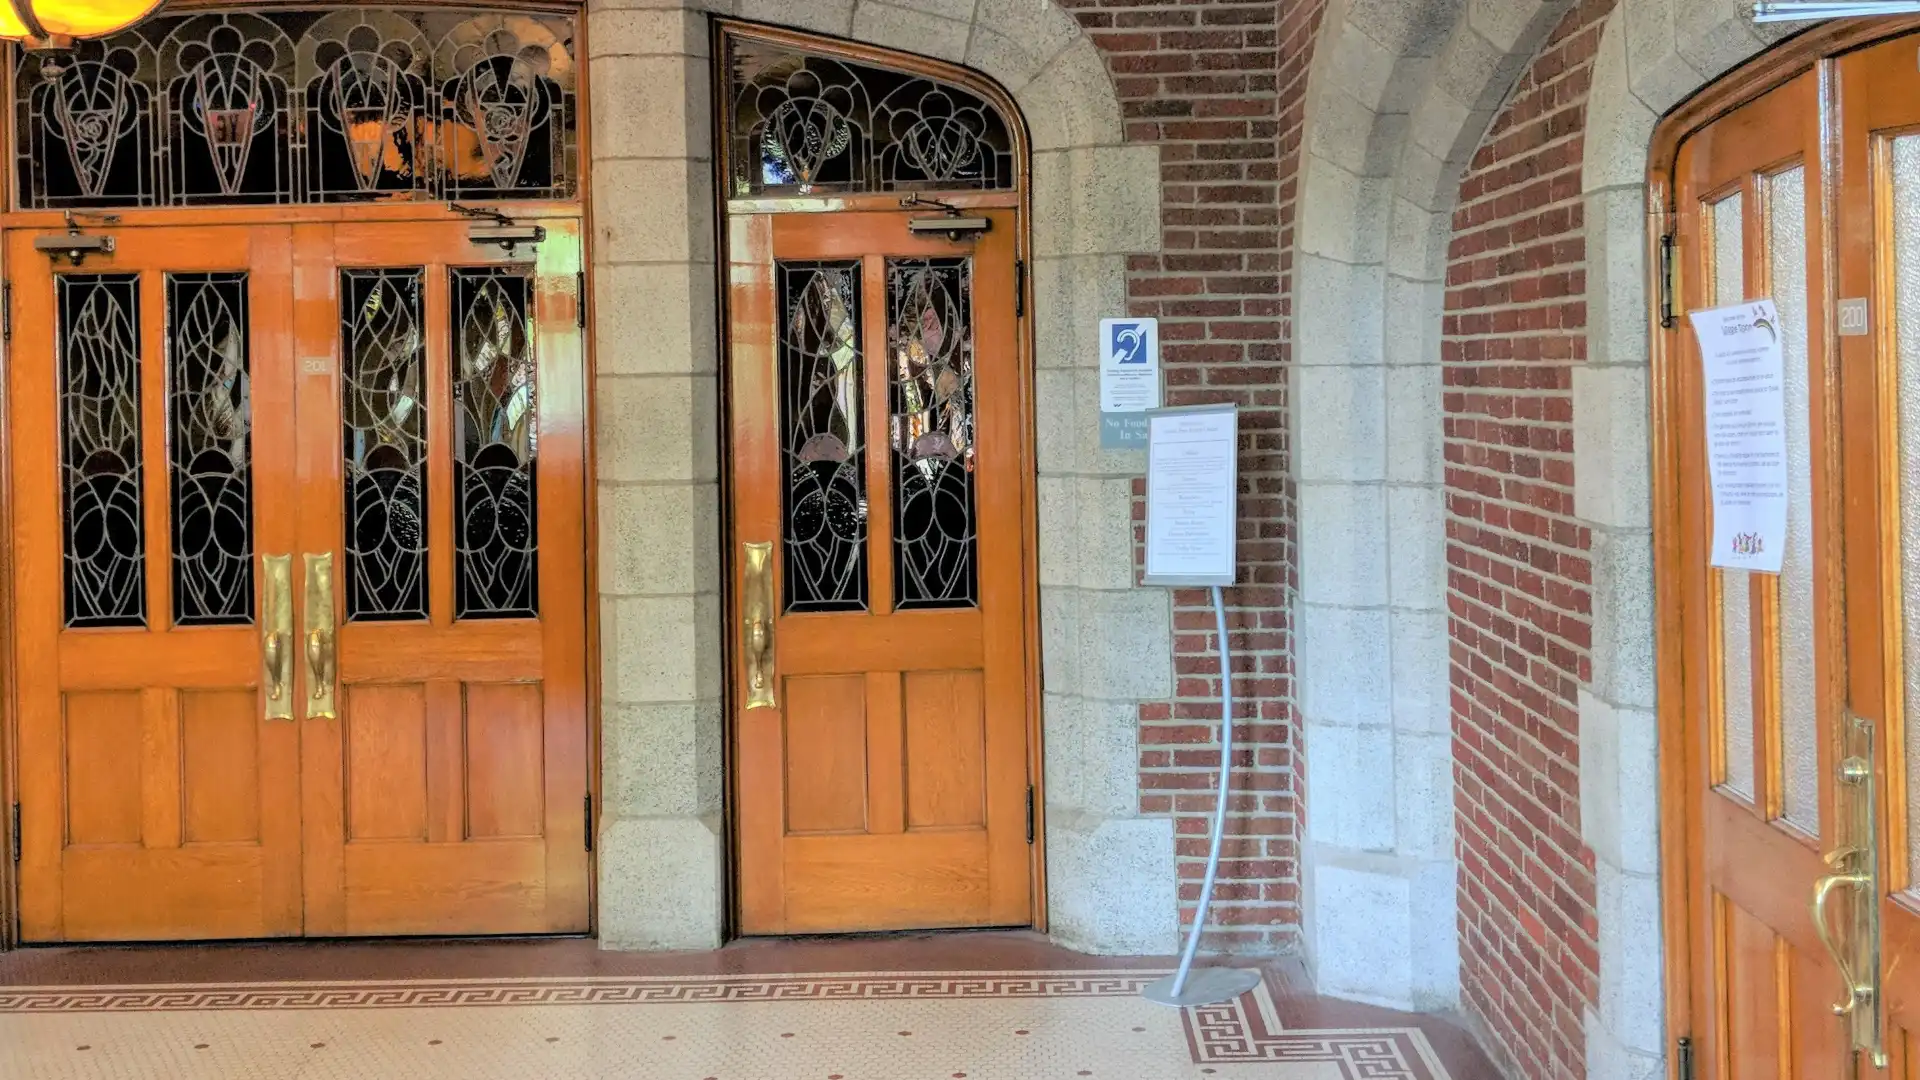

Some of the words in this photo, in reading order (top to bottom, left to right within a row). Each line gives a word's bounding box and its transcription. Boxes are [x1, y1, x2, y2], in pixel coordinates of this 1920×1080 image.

[1842, 306, 1863, 327] 200
[1105, 418, 1120, 428] No
[1124, 418, 1148, 428] Food
[1120, 430, 1131, 440] In
